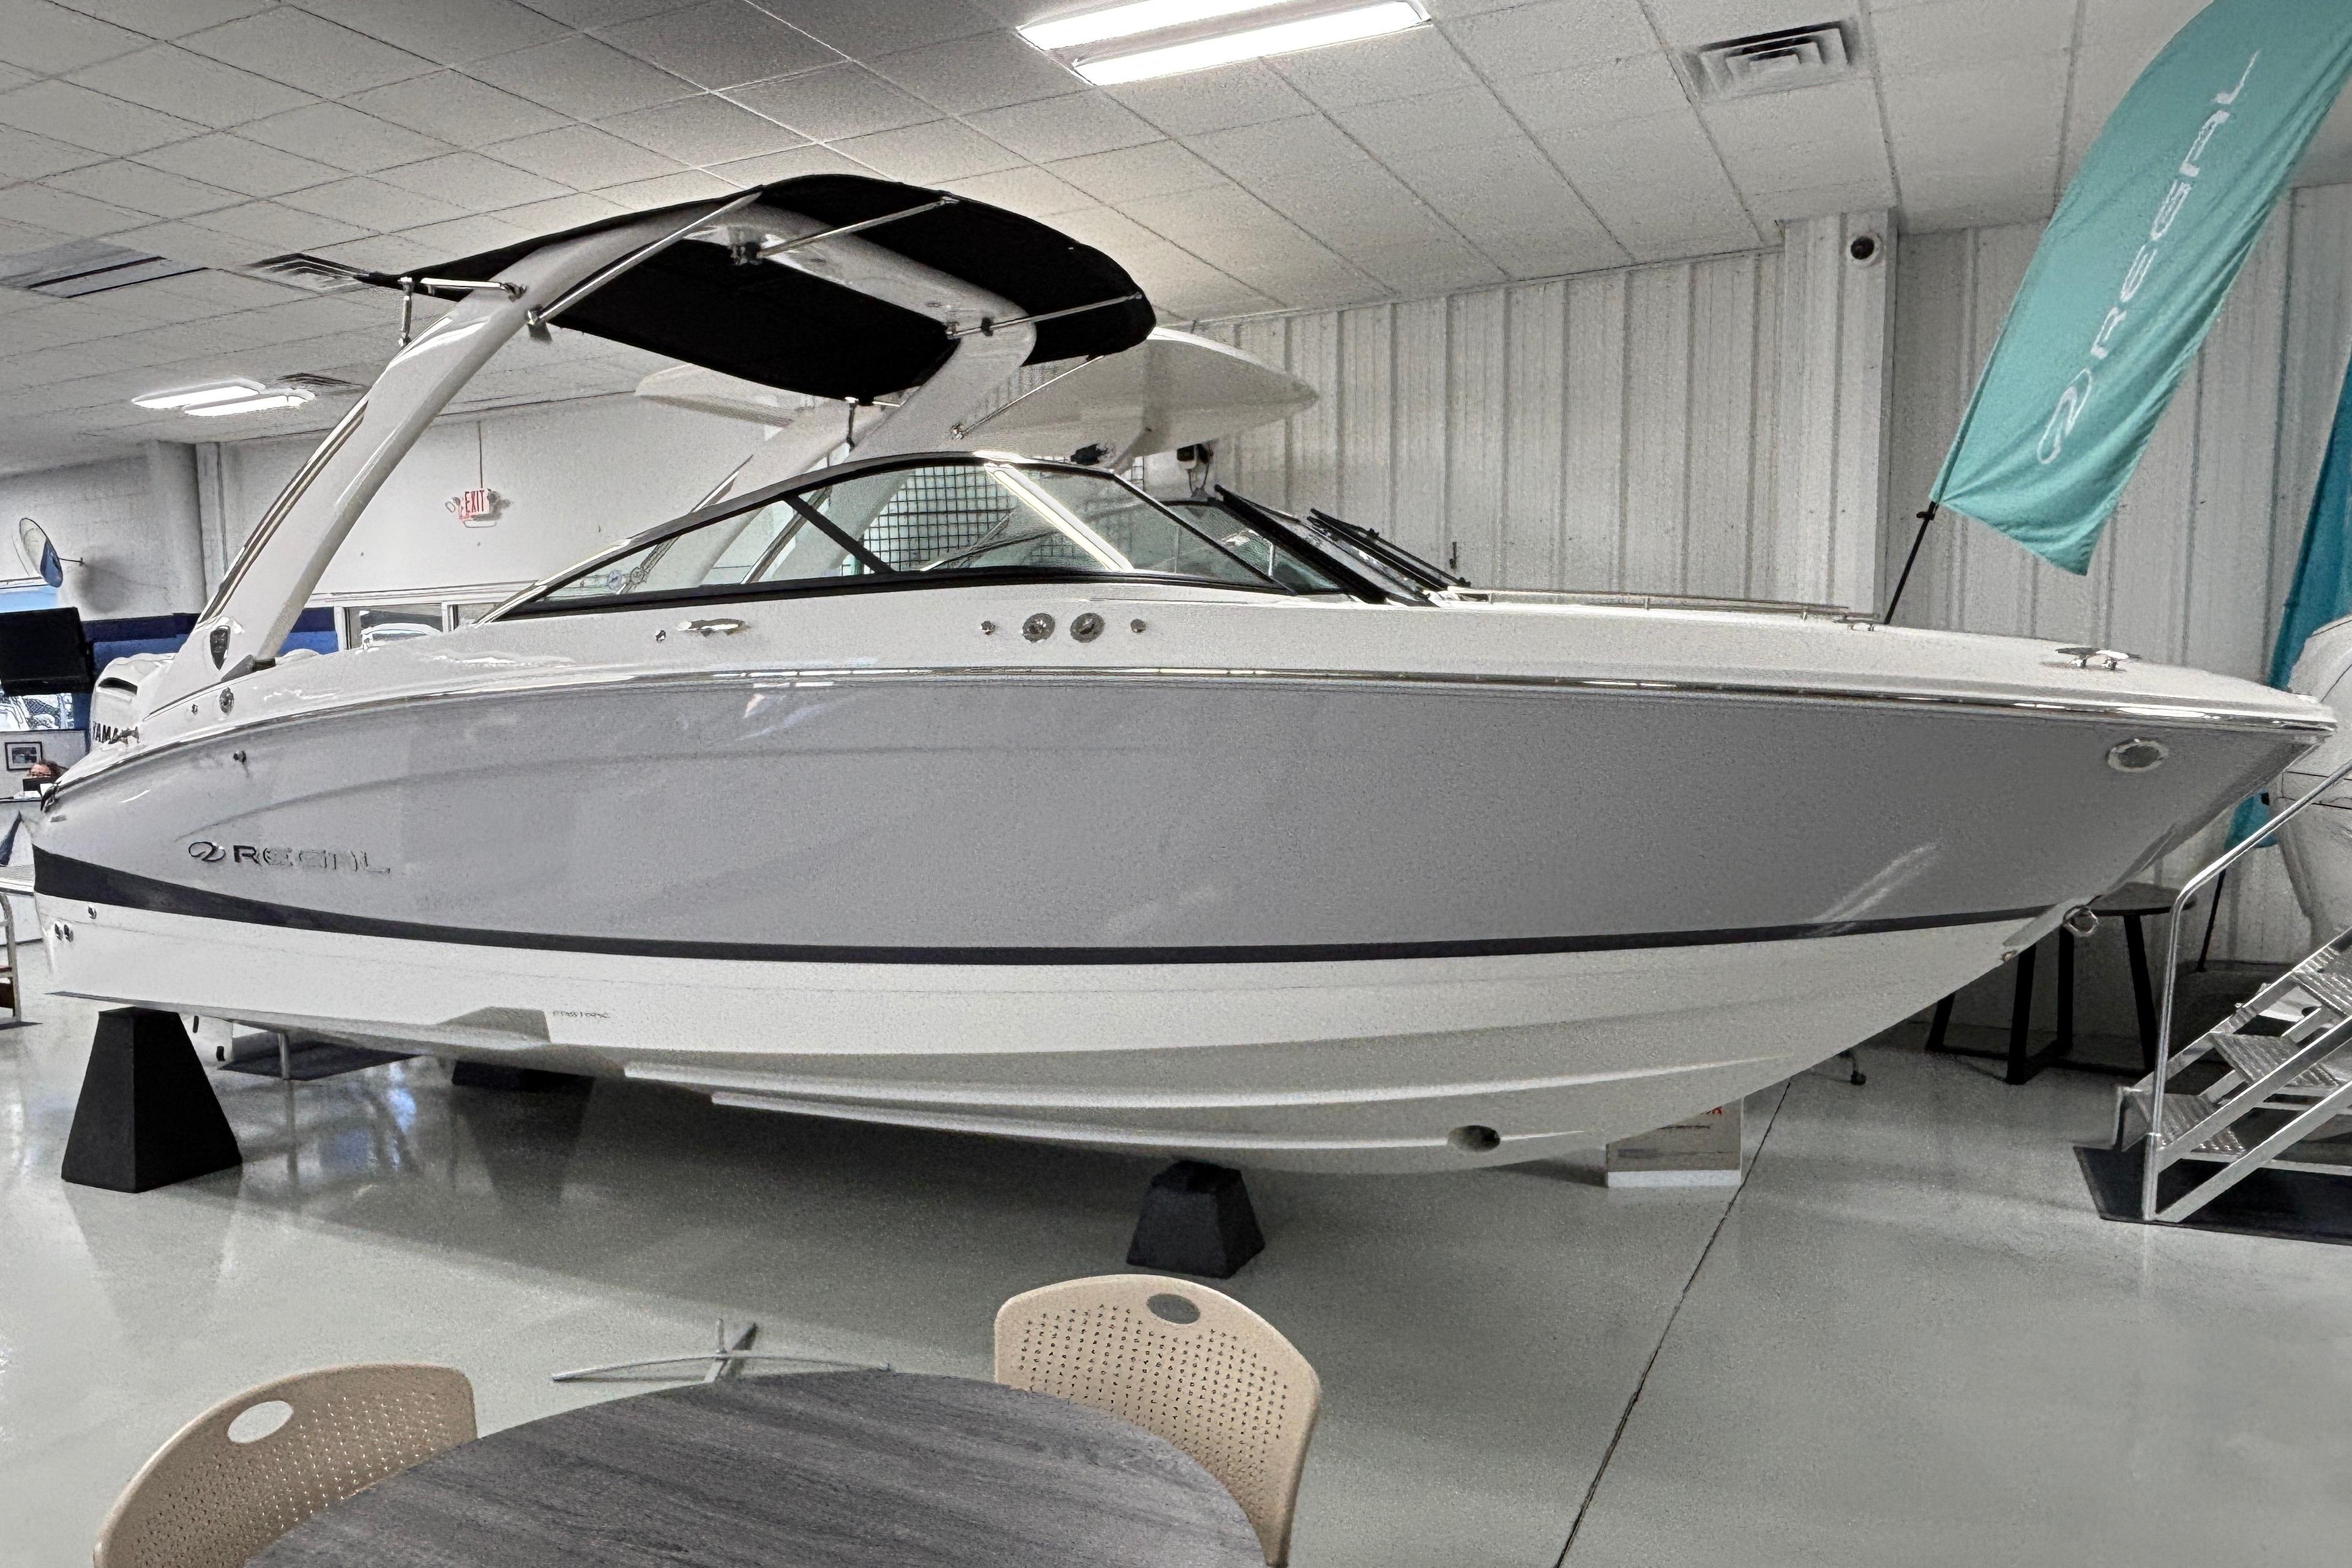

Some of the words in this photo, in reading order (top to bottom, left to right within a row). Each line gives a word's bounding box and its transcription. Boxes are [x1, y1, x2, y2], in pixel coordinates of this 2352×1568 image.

[2090, 50, 2260, 360] REGAL
[465, 490, 485, 513] EXIT
[233, 844, 391, 875] REGAL
